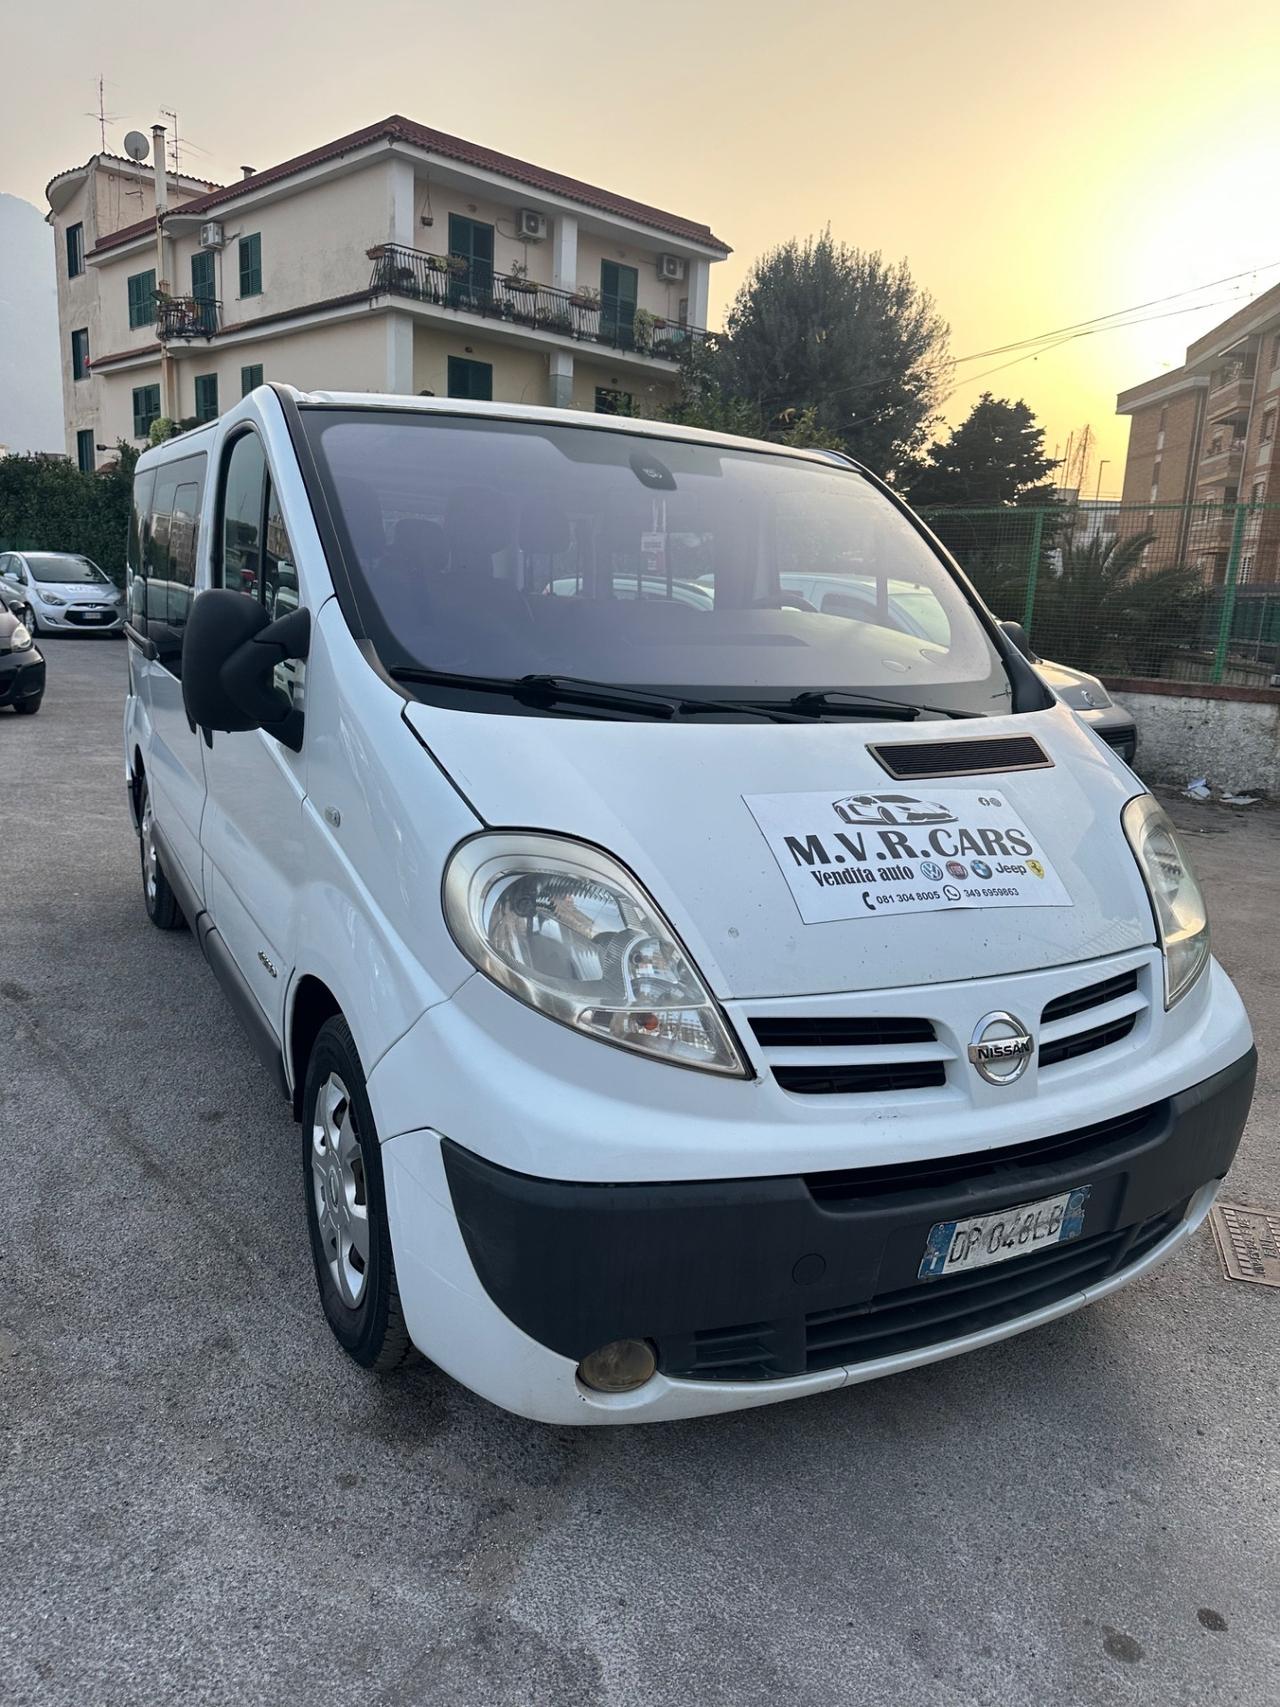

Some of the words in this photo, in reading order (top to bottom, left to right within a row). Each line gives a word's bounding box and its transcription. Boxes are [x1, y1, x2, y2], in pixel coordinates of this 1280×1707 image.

[810, 867, 877, 887] Vendita
[877, 864, 915, 881] auto
[995, 862, 1027, 875] Jeep
[876, 894, 894, 905] 081
[896, 893, 915, 903] 304
[916, 890, 941, 901] 8005
[963, 888, 981, 898] 349
[981, 887, 1020, 897] 6959863
[977, 1040, 1030, 1060] NISSAN
